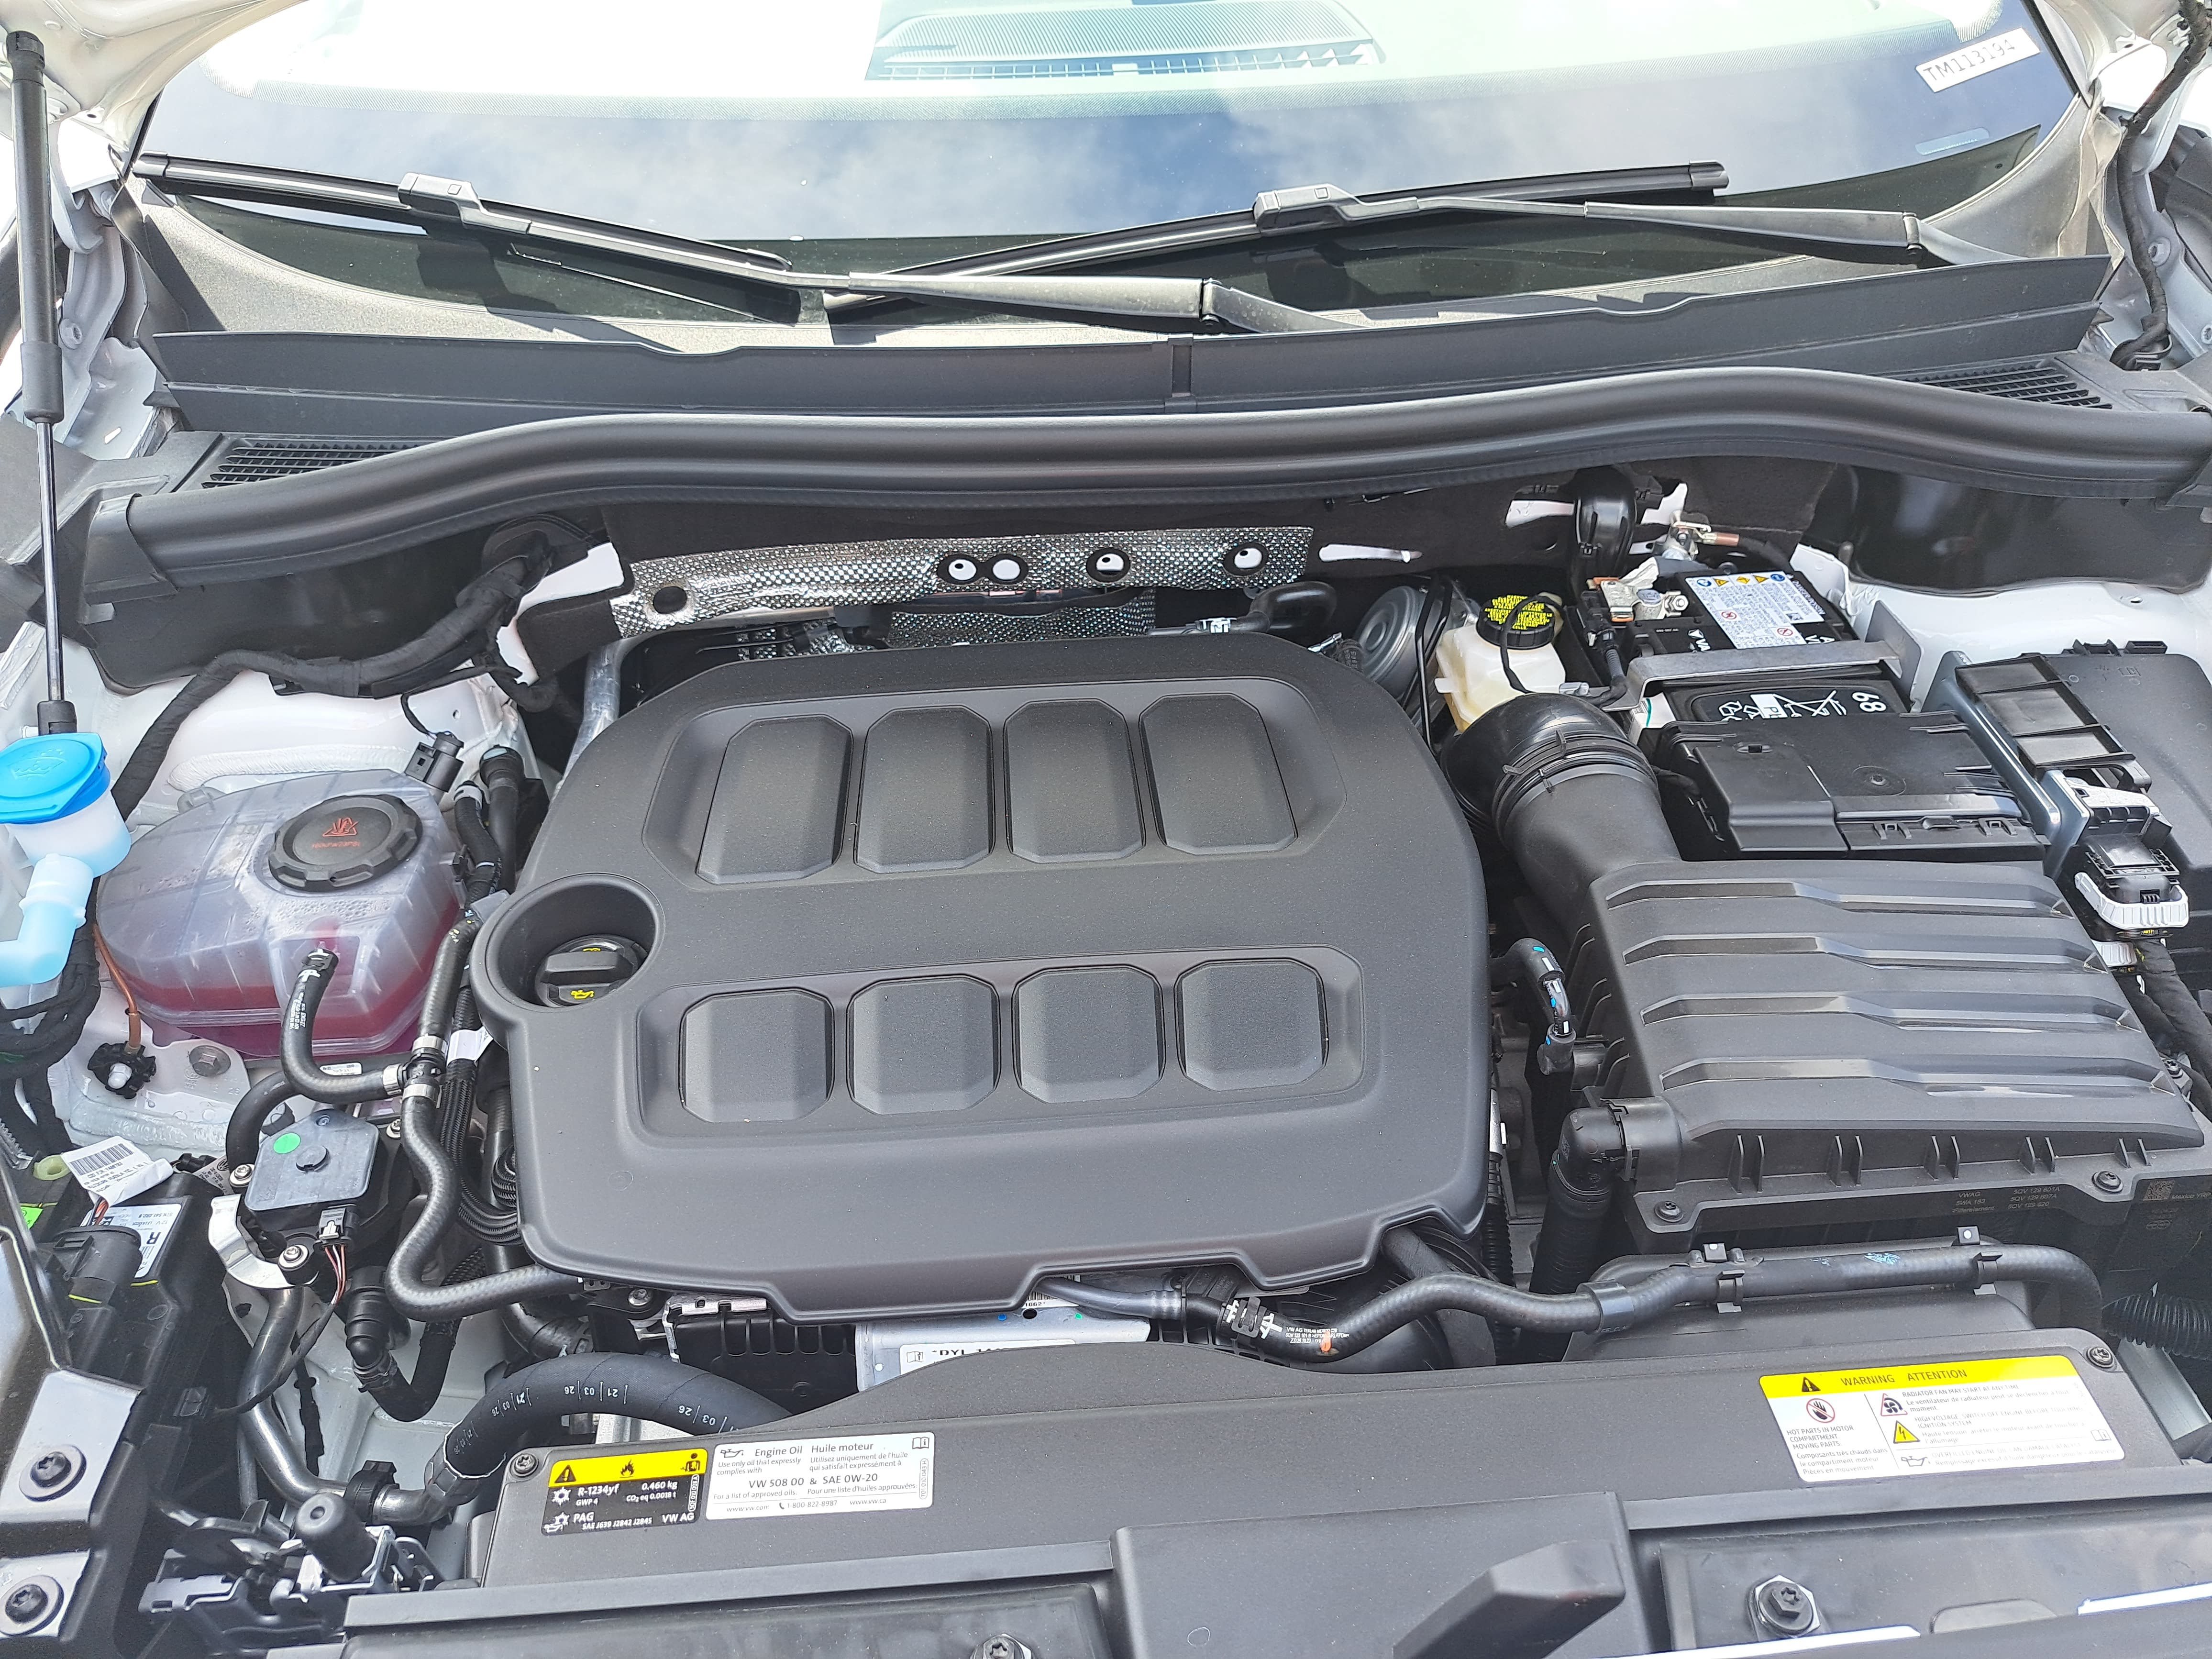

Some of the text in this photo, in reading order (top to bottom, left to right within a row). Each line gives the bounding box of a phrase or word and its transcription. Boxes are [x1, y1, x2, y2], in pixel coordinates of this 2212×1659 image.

[1923, 38, 2015, 82] TM113194
[146, 1232, 161, 1244] R
[1840, 1369, 1968, 1386] WARNING ATTENTION
[755, 1446, 802, 1458] Engine Oil
[811, 1442, 874, 1453] Huile moteur
[836, 1453, 876, 1462] uniquement
[1795, 1451, 1836, 1460] Composants
[771, 1457, 801, 1466] expressly
[1806, 1458, 1854, 1467] compartiment
[717, 1469, 745, 1477] complies
[667, 1480, 678, 1490] kg
[748, 1480, 766, 1488] VW
[769, 1478, 787, 1487] 508
[790, 1477, 804, 1486] 00
[822, 1475, 841, 1484] SAE
[577, 1483, 619, 1498] R-1234yf
[751, 1490, 783, 1499] approved
[649, 1492, 671, 1500] 0.0018
[787, 1500, 837, 1508] 1-800-822-8987
[573, 1512, 594, 1523] PAG
[661, 1512, 695, 1523] VW AG
